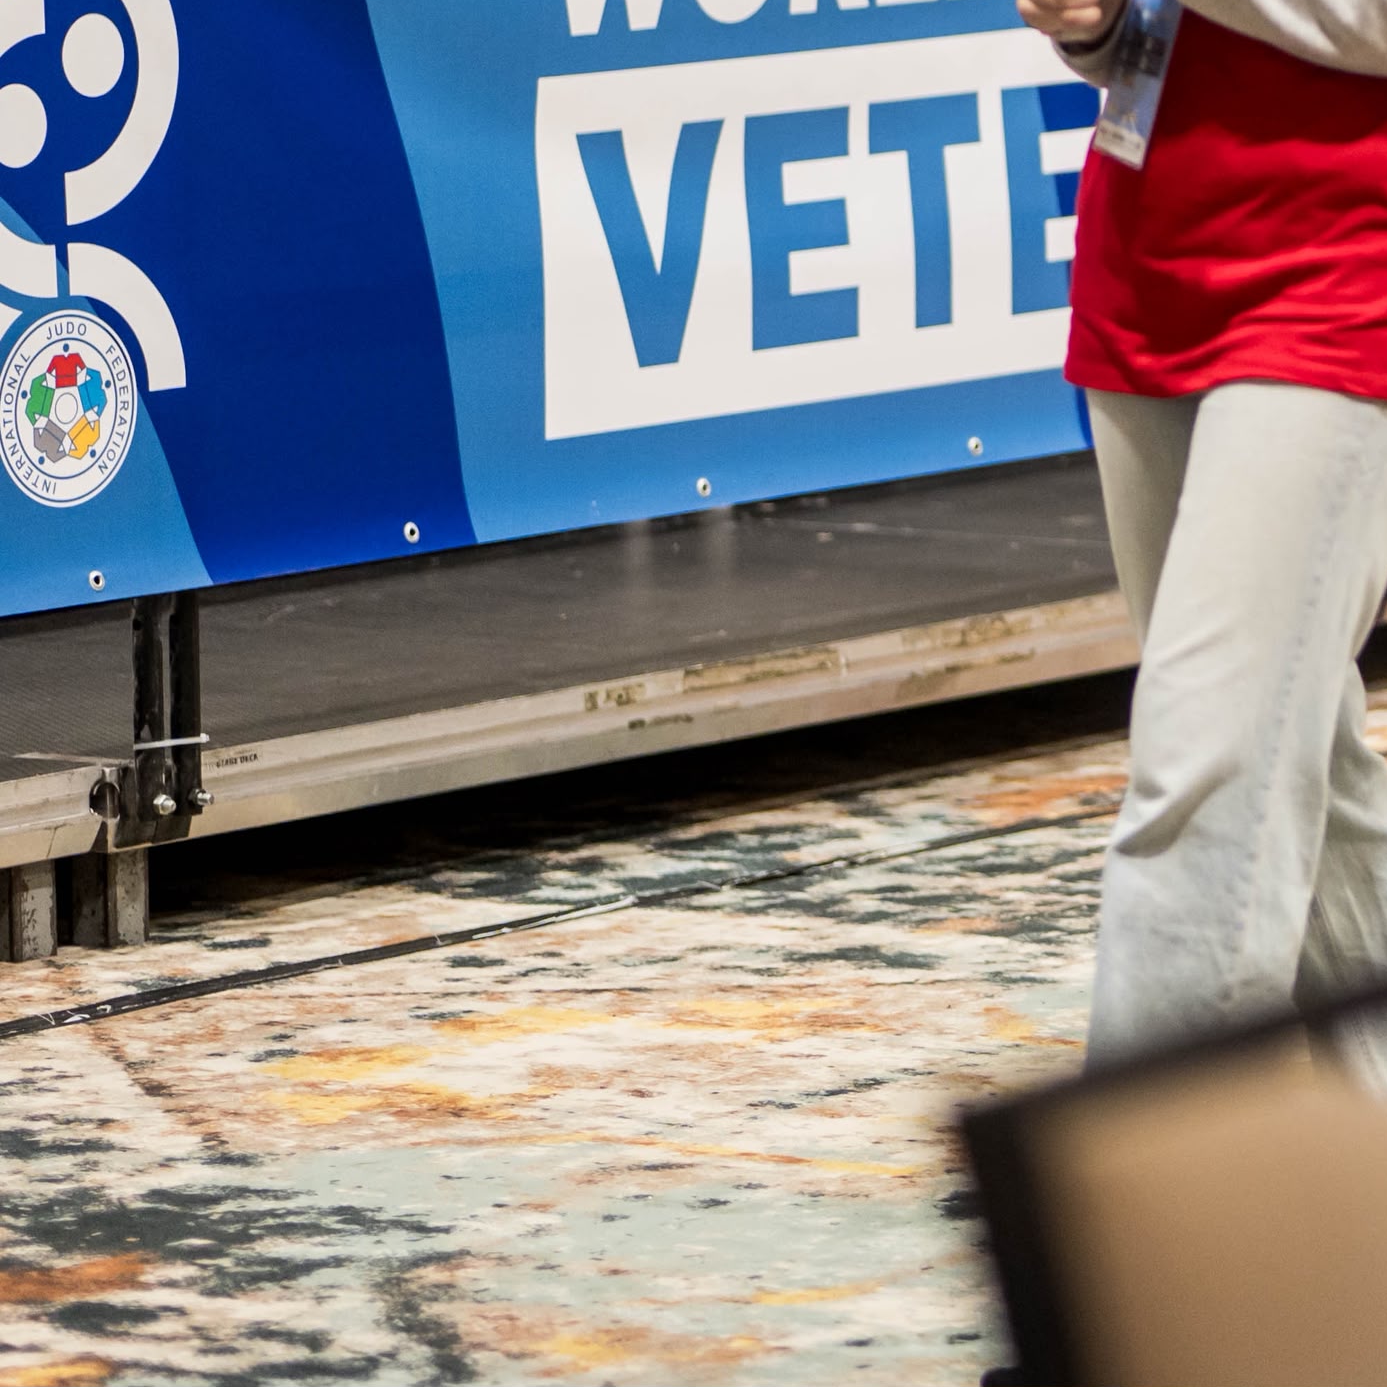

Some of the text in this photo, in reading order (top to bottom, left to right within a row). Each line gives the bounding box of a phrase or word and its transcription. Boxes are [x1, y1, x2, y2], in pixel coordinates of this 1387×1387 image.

[2, 321, 130, 495] INTERNATIONAL JUDO FEDERATION
